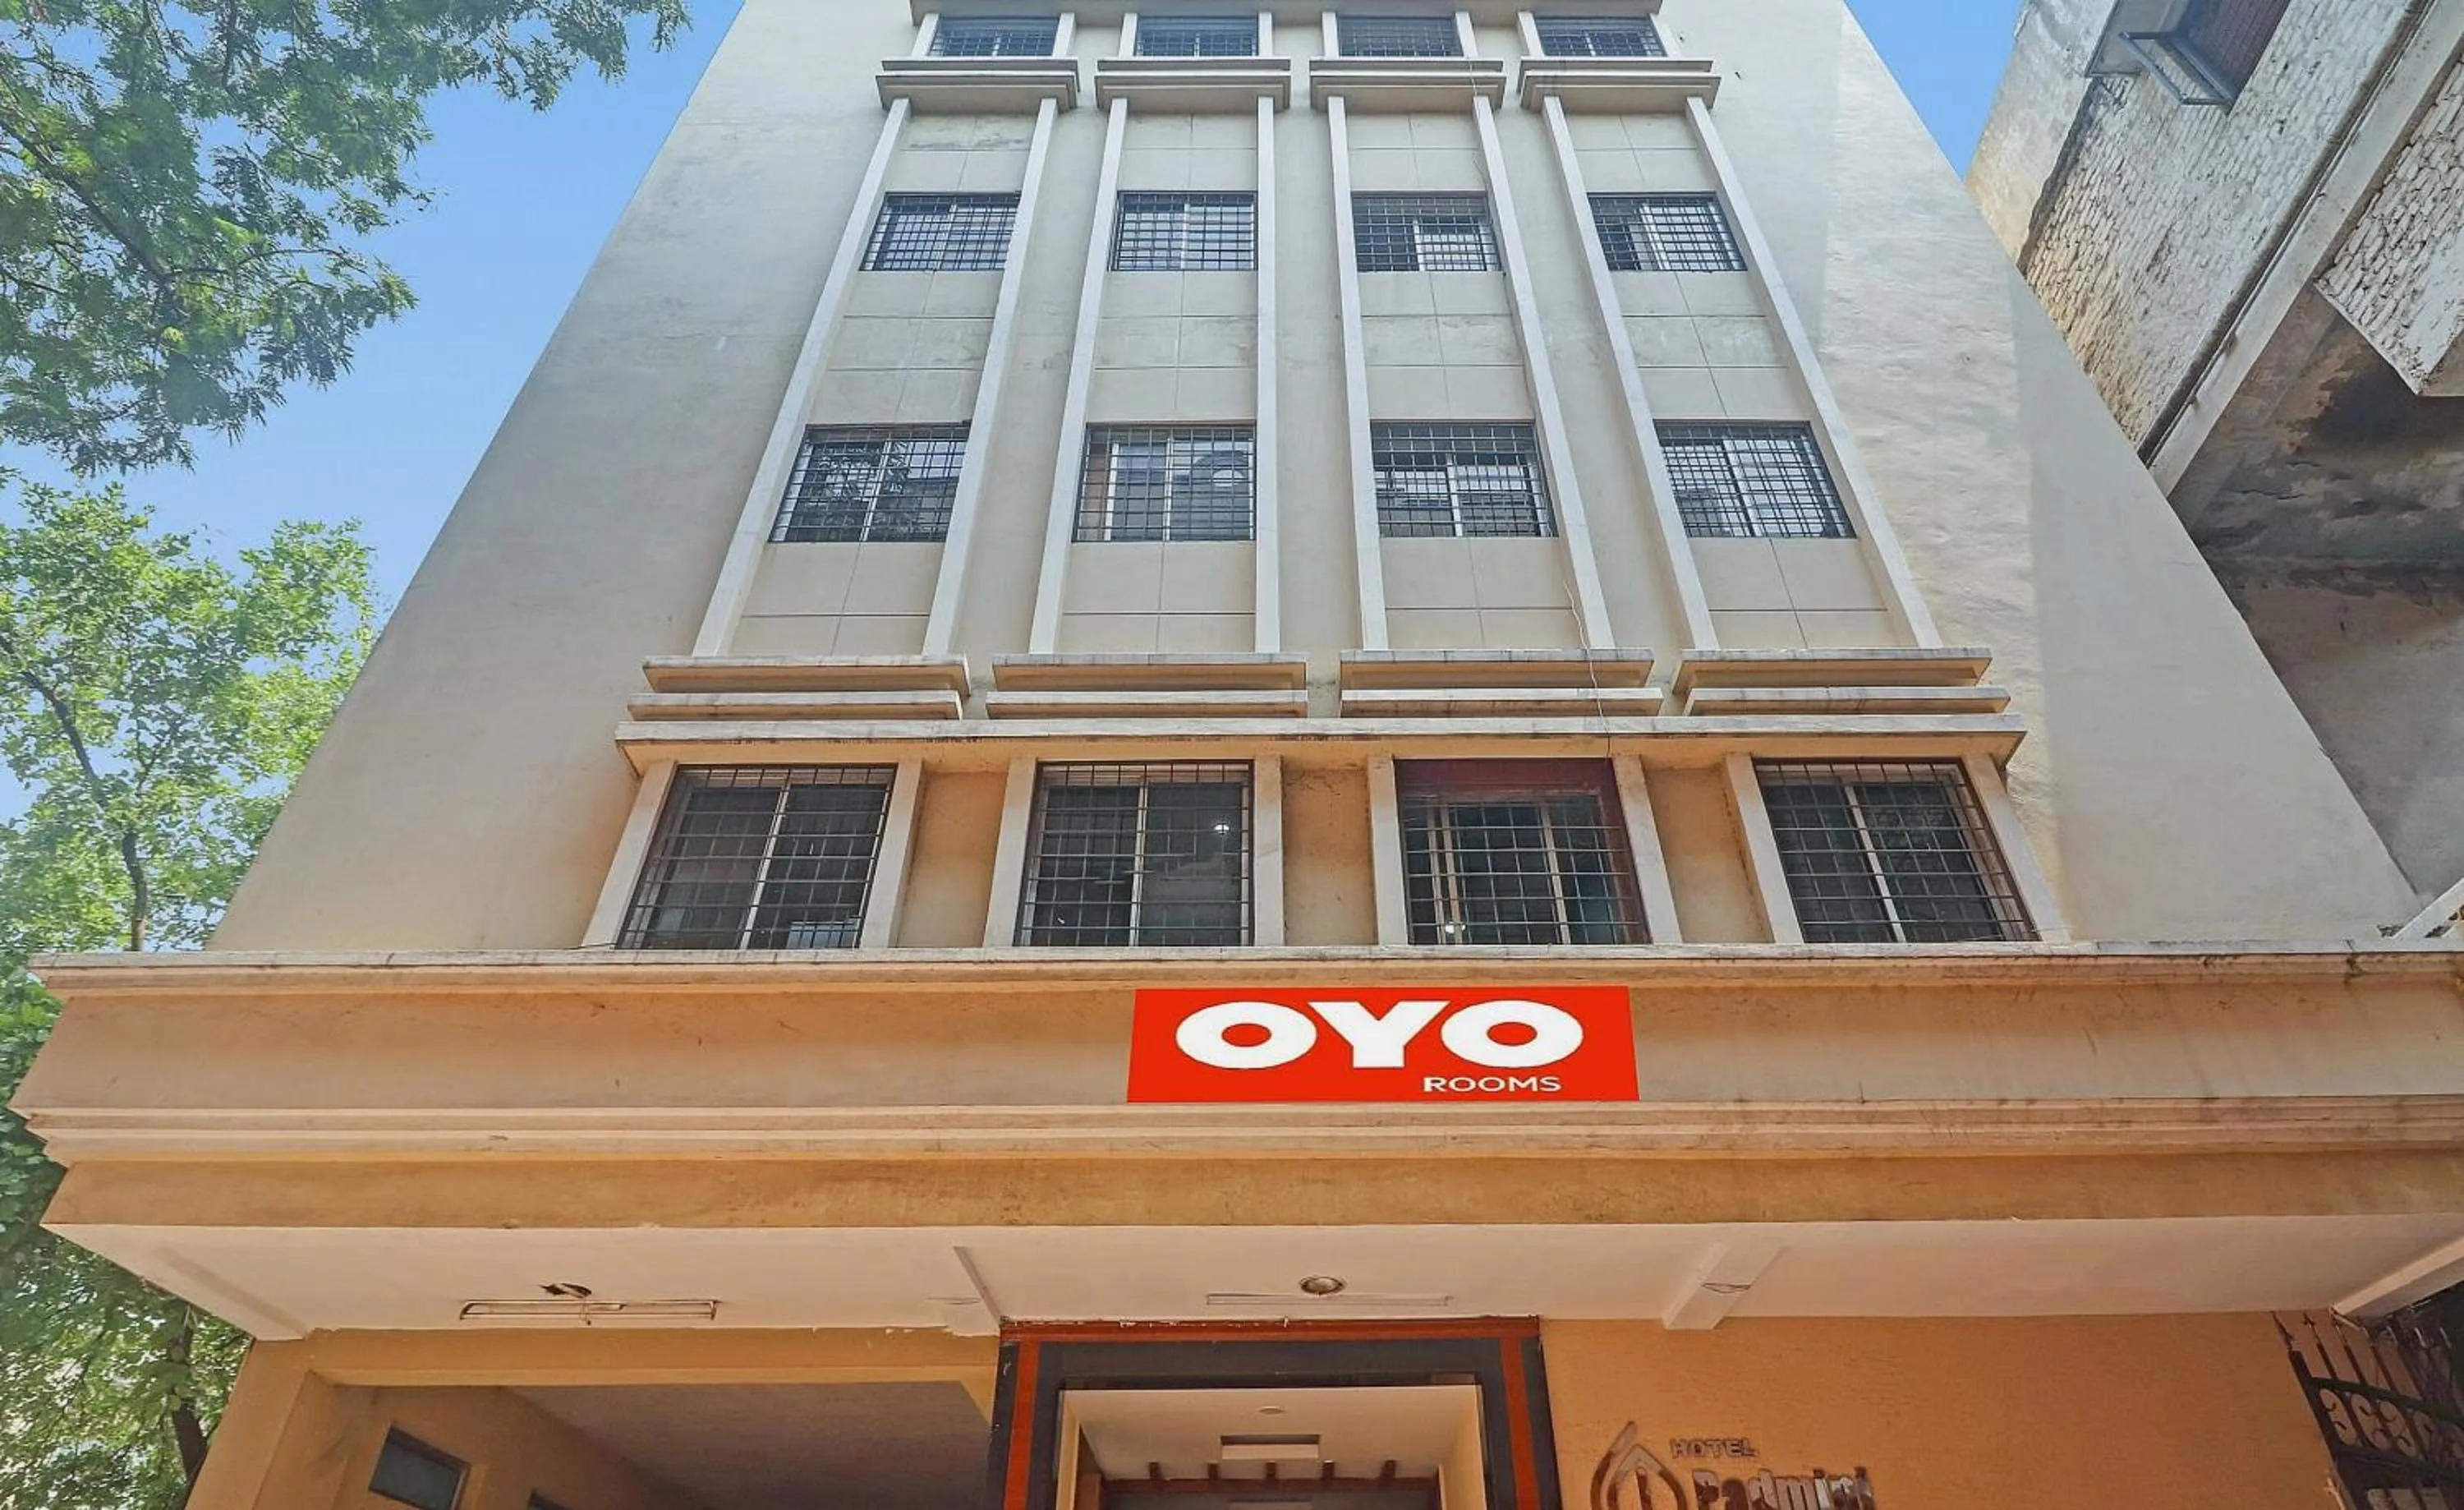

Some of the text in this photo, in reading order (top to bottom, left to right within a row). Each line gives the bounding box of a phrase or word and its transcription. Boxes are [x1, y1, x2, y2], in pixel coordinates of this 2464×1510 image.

[1175, 1000, 1584, 1069] OYO
[1423, 1076, 1561, 1092] ROOMS
[1670, 1438, 1758, 1458] HOTEL
